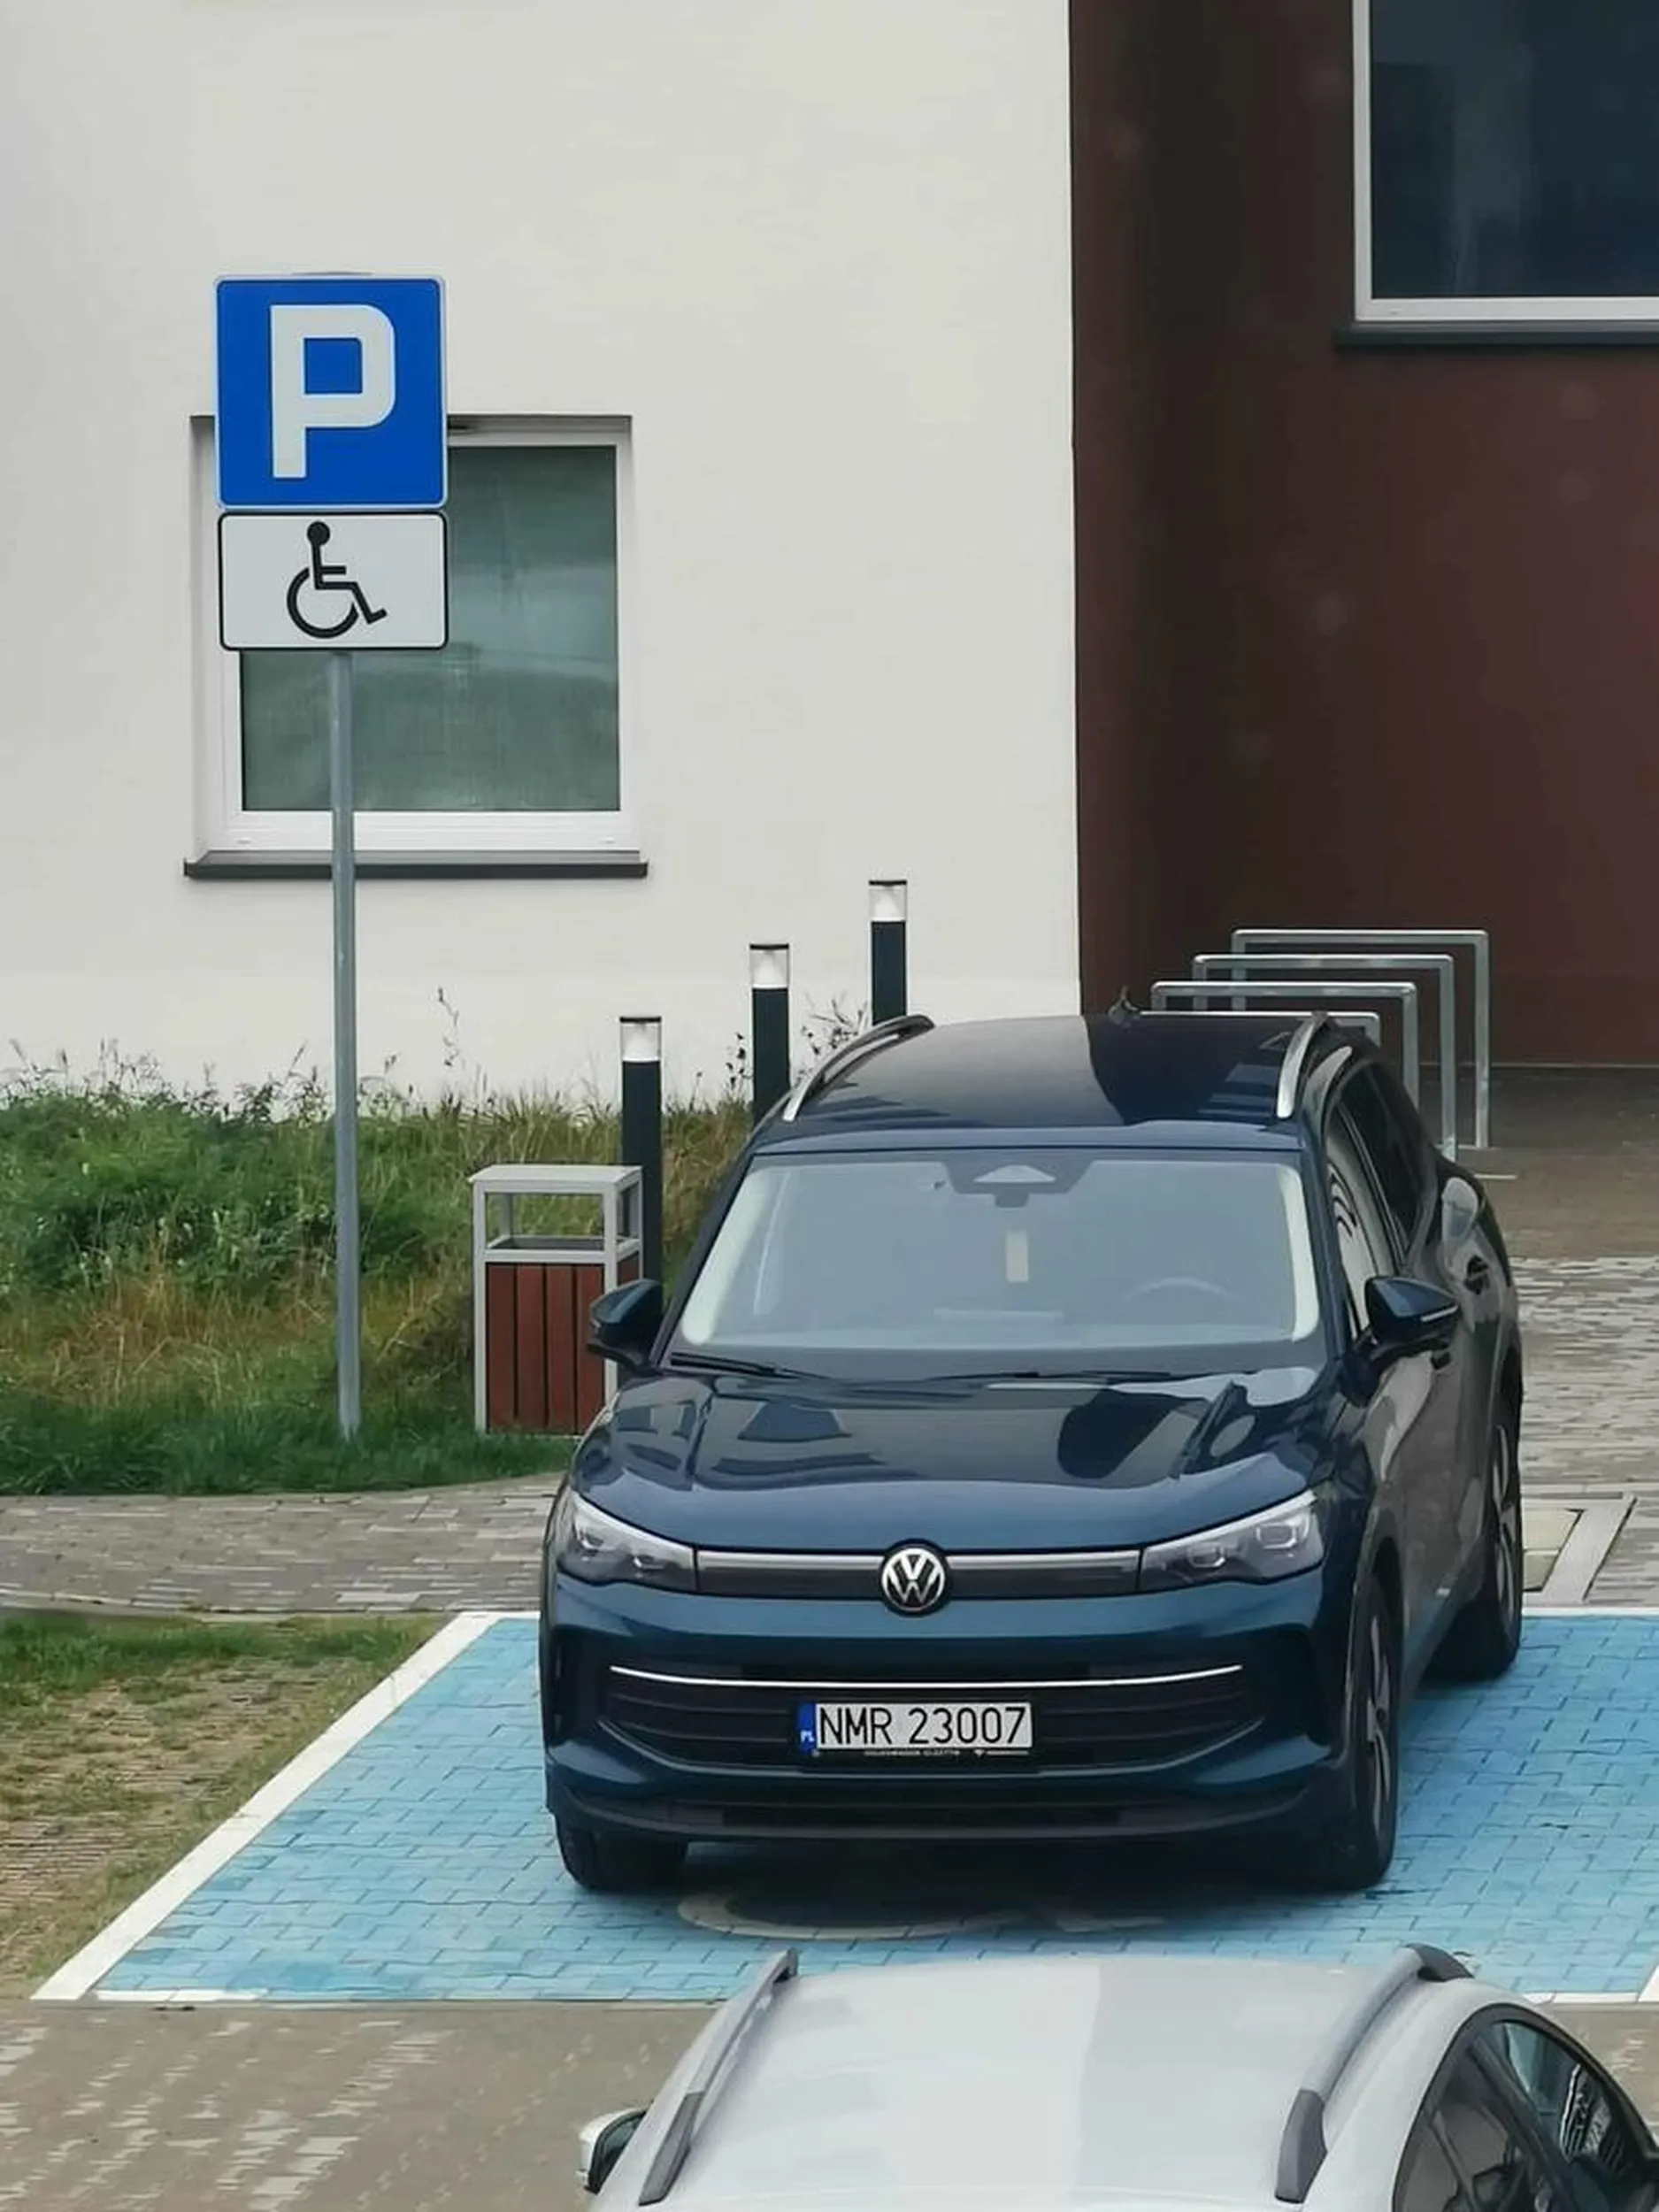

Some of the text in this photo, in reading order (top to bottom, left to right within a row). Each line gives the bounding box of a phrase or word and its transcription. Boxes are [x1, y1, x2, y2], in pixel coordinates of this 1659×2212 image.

[270, 304, 396, 479] P
[882, 1548, 945, 1610] VW
[819, 1707, 1026, 1745] NMR 23007
